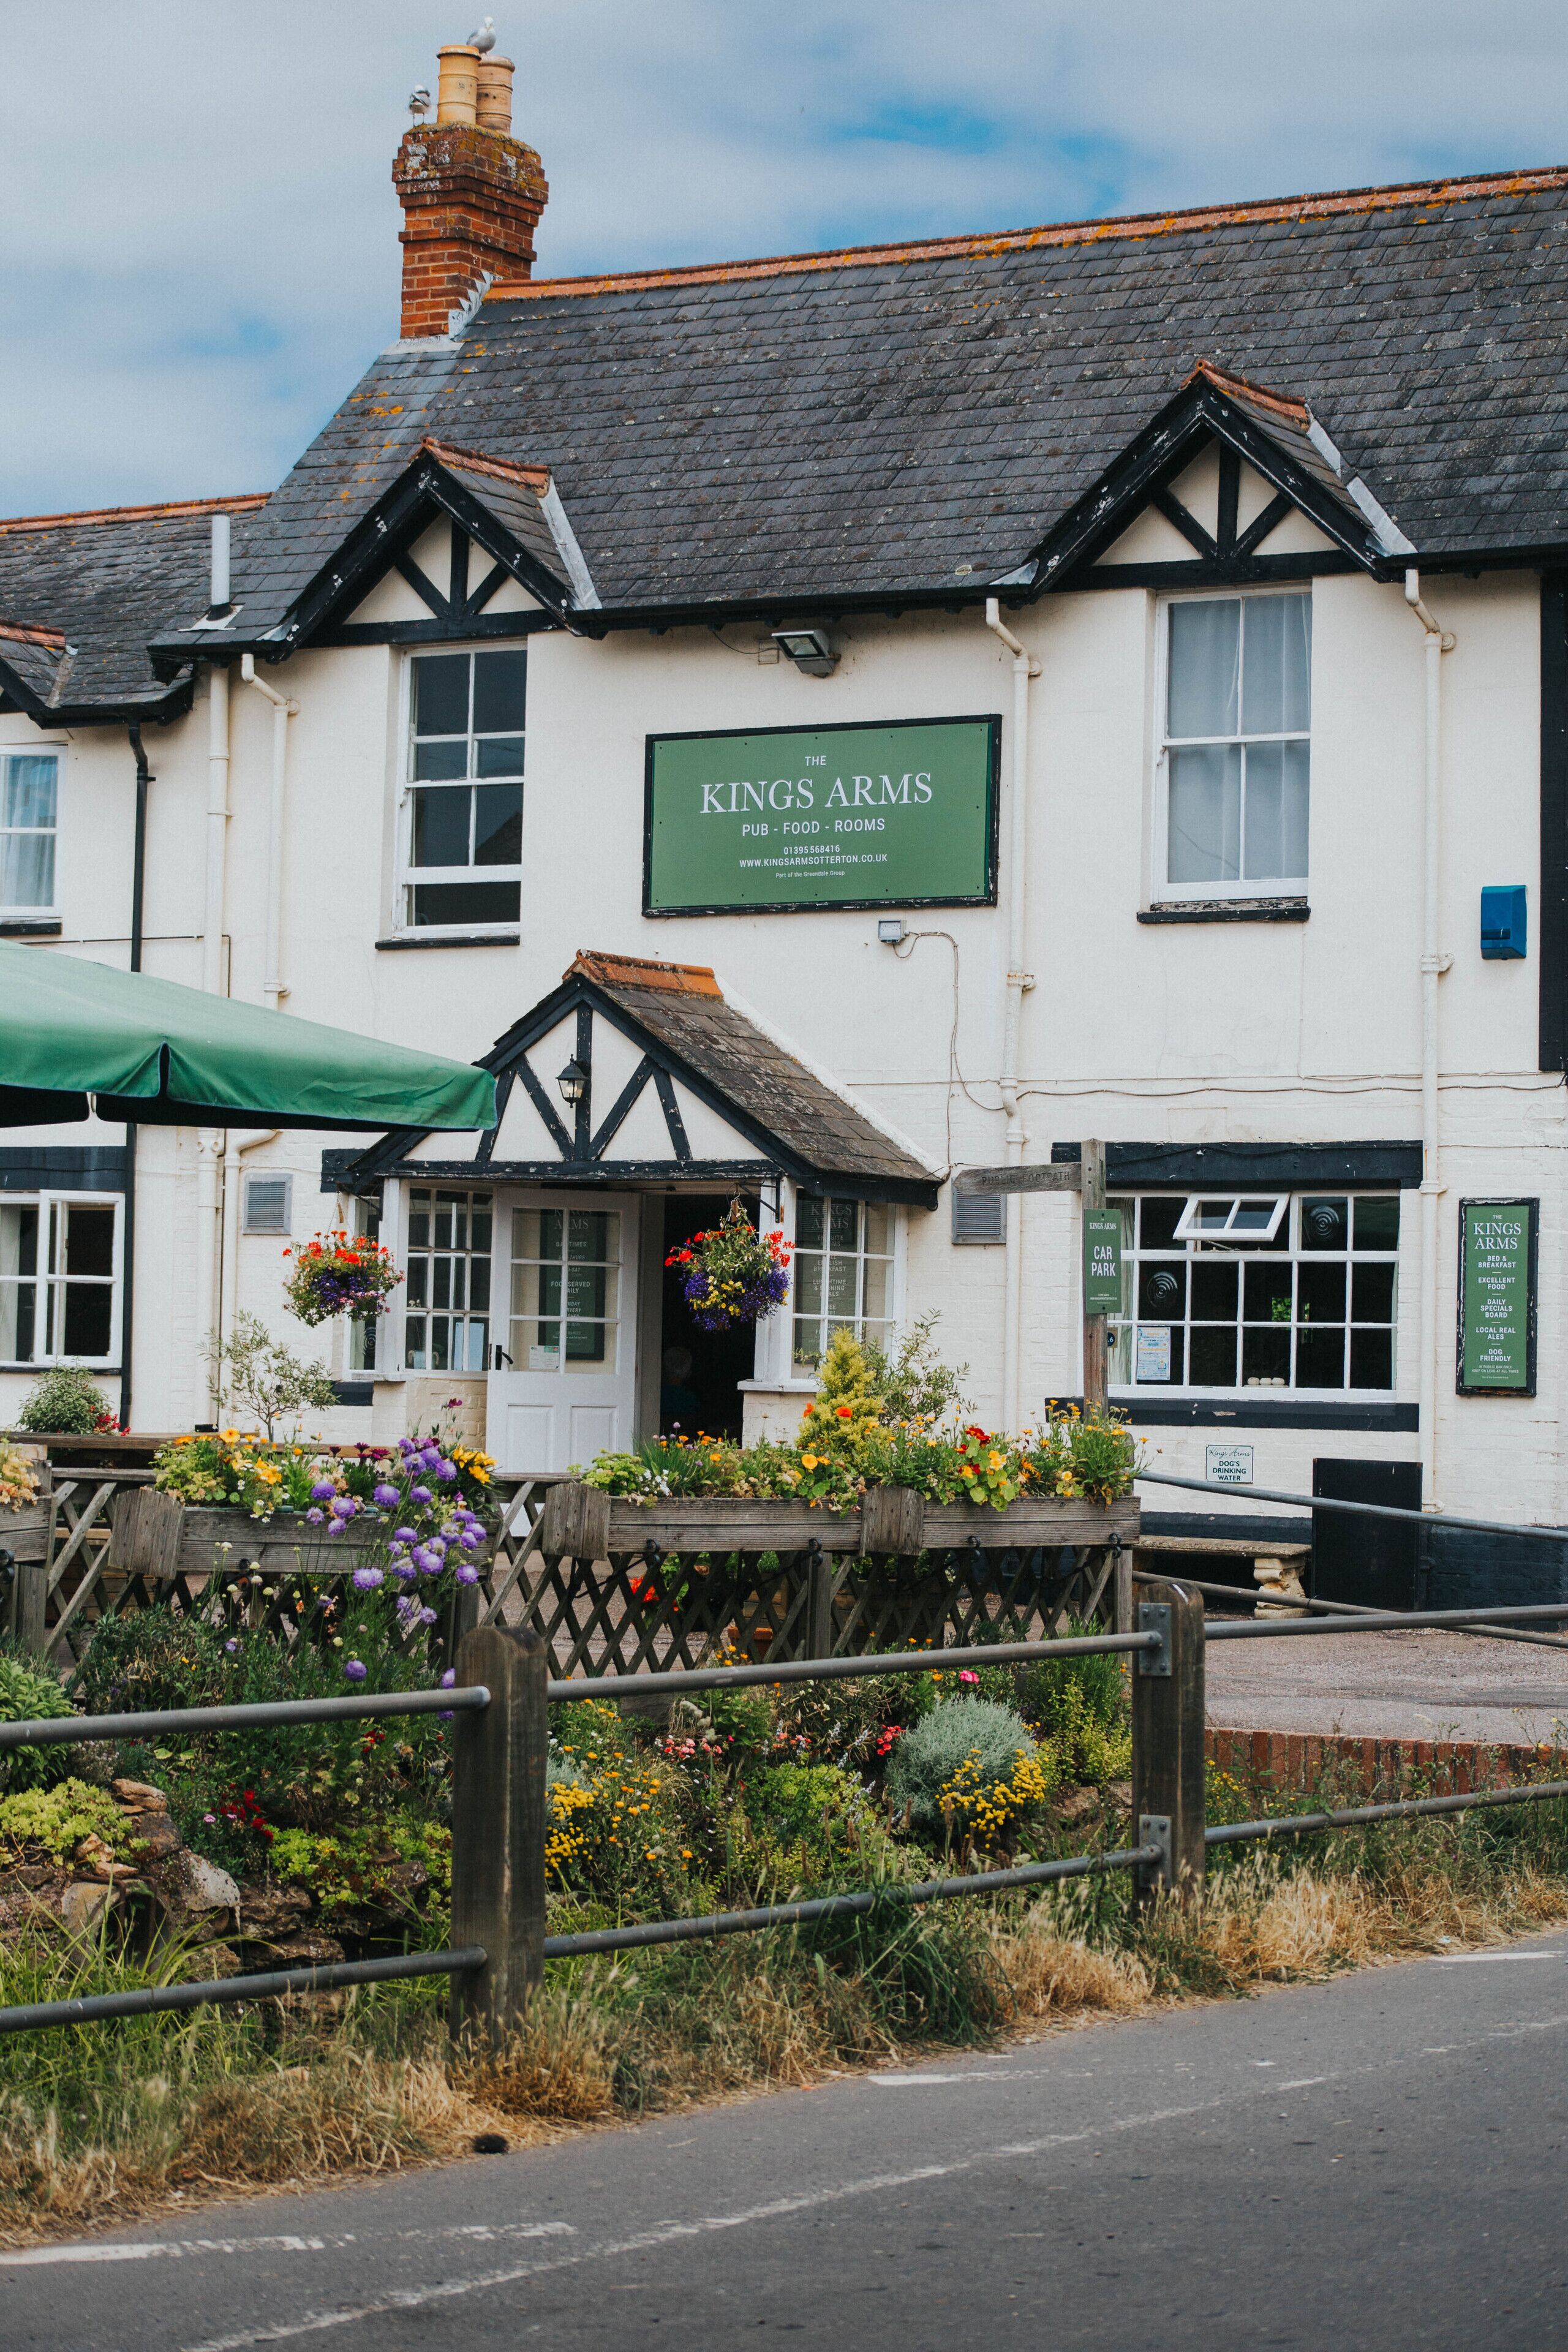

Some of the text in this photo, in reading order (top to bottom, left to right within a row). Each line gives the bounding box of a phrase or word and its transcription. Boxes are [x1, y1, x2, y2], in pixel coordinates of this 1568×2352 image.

[804, 755, 827, 766] THE
[700, 772, 932, 813] KINGS ARMS
[742, 824, 769, 837] PUB
[783, 821, 820, 835] FOOD
[835, 818, 886, 833] ROOMS
[783, 845, 840, 854] 01395 568416
[739, 854, 888, 867] WWW.KINGSARMSOTTERTON.CO.UK
[982, 1171, 1070, 1186] PUBLIC FOOTPATH
[1473, 1223, 1521, 1235] KINGS
[1474, 1237, 1518, 1250] ARMS
[1093, 1245, 1112, 1260] CAR
[1091, 1262, 1116, 1276] PARK
[1229, 1447, 1250, 1457] Arms
